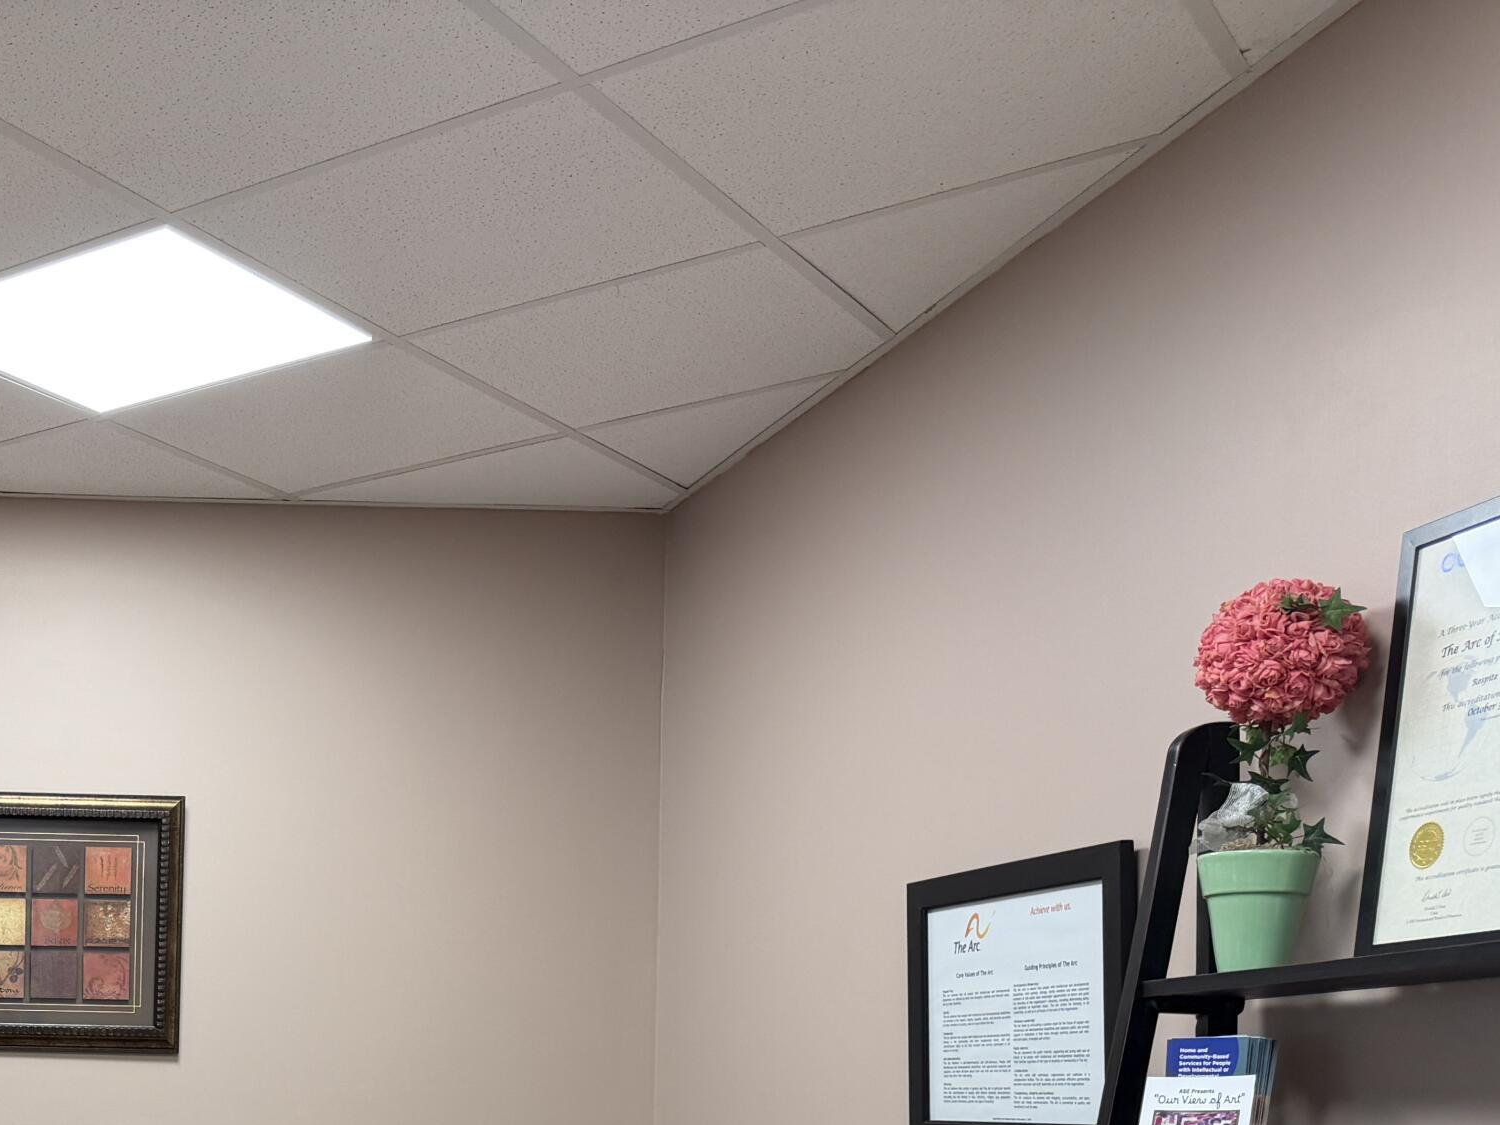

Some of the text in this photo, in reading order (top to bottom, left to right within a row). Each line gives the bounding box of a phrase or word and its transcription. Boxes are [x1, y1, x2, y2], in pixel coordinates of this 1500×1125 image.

[1442, 630, 1497, 658] The Arc of
[1467, 702, 1497, 717] October
[88, 884, 126, 894] Serenity
[1050, 902, 1062, 912] with
[954, 940, 980, 954] The Arc
[1212, 1060, 1232, 1068] People
[1182, 1094, 1207, 1105] View
[1208, 1092, 1222, 1110] of
